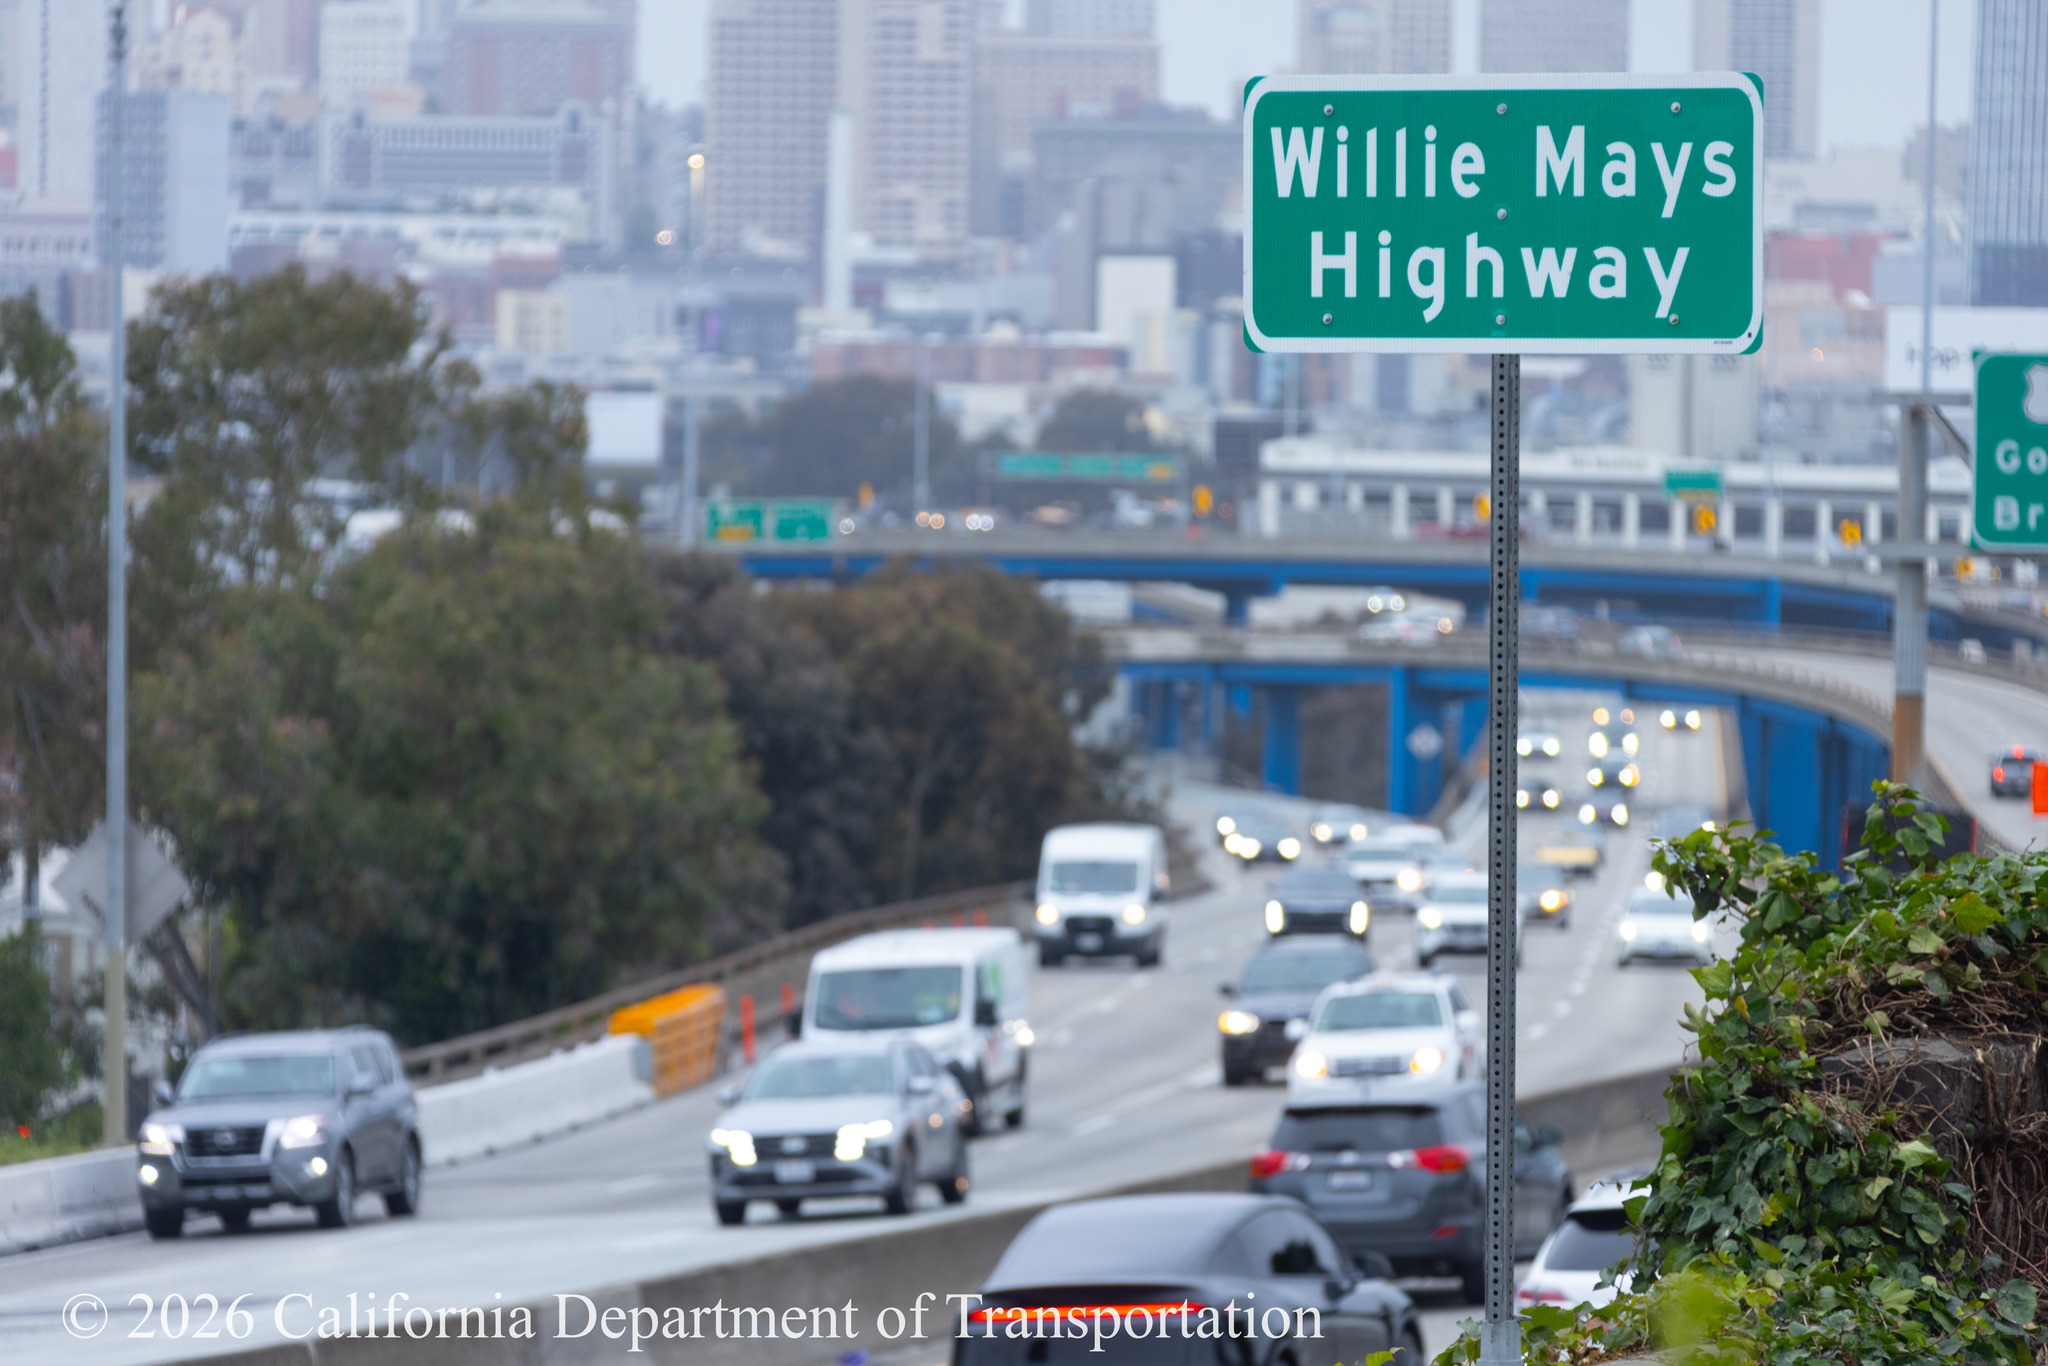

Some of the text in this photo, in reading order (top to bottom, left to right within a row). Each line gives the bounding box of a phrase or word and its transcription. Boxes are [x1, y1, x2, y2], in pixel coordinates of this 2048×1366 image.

[1271, 125, 1736, 218] Willie Mays
[1311, 230, 1690, 323] Highway
